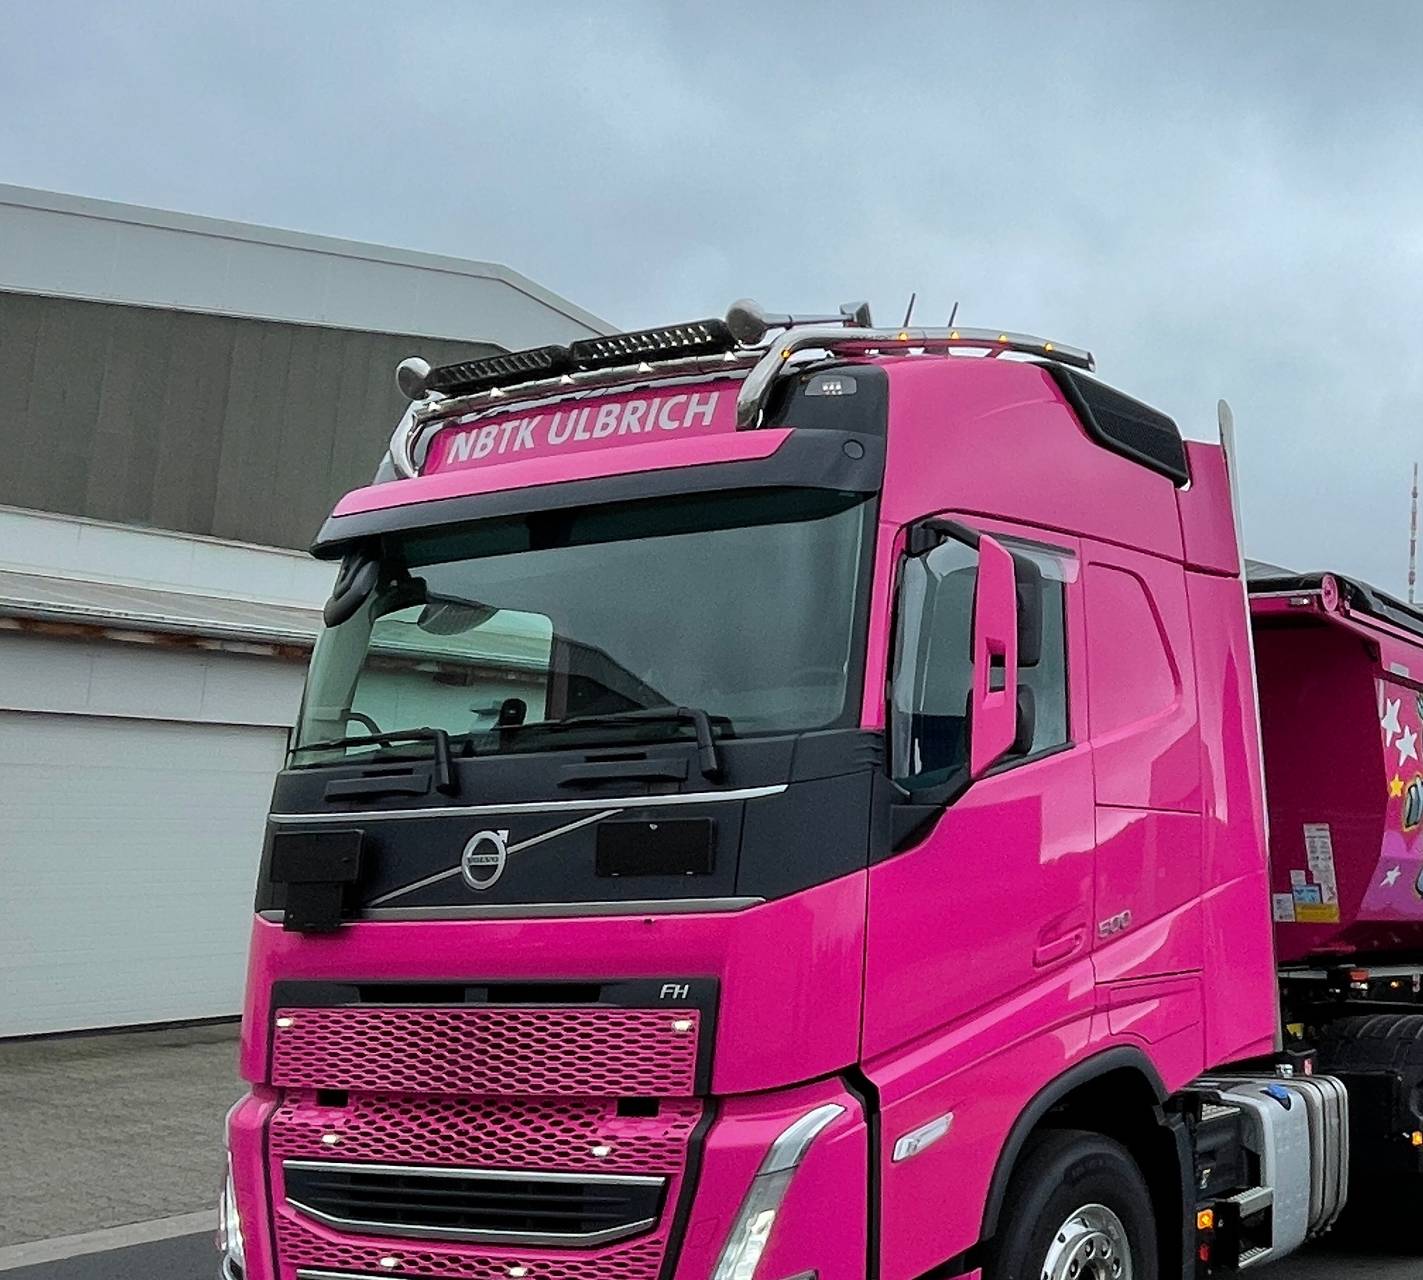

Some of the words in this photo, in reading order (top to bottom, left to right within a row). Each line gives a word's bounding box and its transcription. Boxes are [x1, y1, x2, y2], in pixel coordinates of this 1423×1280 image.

[446, 414, 545, 465] NBTK
[547, 390, 721, 446] ULBRICH
[467, 856, 500, 864] VOLVO
[1098, 909, 1131, 938] 500
[659, 983, 690, 999] FH
